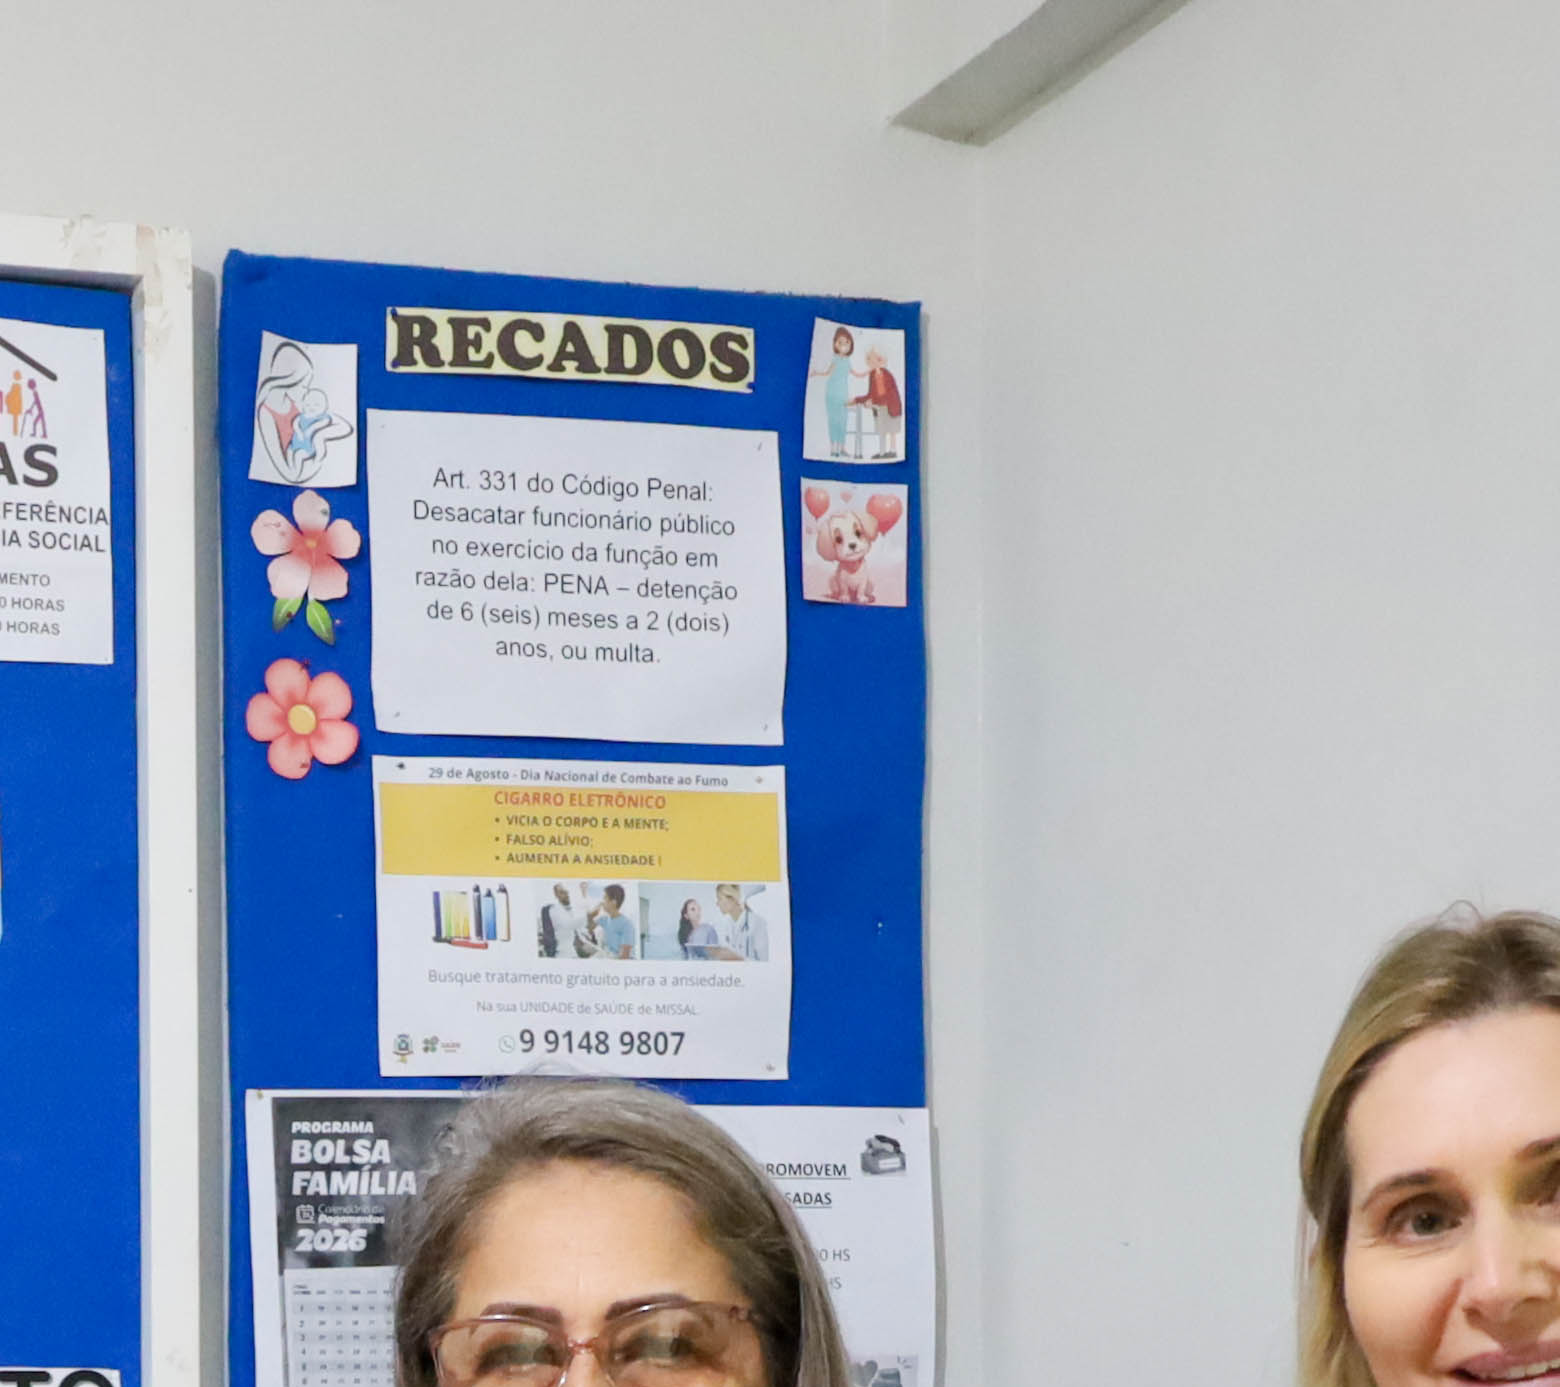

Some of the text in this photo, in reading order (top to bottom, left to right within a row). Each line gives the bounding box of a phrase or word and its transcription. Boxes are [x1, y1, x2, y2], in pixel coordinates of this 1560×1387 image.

[393, 313, 752, 384] RECADOS
[432, 468, 713, 502] Art. 331 do Código Penal:
[413, 500, 735, 538] Desacatar funcionário público
[28, 531, 106, 552] SOCIAL
[432, 537, 719, 570] no exercício da função em
[415, 569, 738, 606] razão dela: PENA detenção
[11, 597, 65, 612] HORAS
[6, 620, 60, 636] HORAS
[426, 600, 730, 637] de 6 (seis) meses a 2 (dois)
[495, 638, 661, 663] anos, ou multa.
[428, 767, 728, 787] 29 de Agosto Dia Nacional de Combate ao Fumo
[493, 791, 667, 810] CIGARRO ELETRÔNICO
[506, 815, 670, 831] VICIA CORPO MENTE;
[506, 834, 545, 846] FALSO
[506, 852, 655, 866] AUMENTA ANSIEDADE
[428, 968, 745, 989] Busque tratamento gratuito para ansiedade.
[520, 1000, 634, 1015] UNIDADE SAÚDE
[519, 1029, 686, 1056] 9 9148 9807
[291, 1121, 374, 1134] PROGRAMA
[290, 1139, 391, 1164] BOLSA
[292, 1164, 416, 1196] FAMÍLIA
[318, 1214, 385, 1225] Pagamentos
[295, 1228, 367, 1252] 2026
